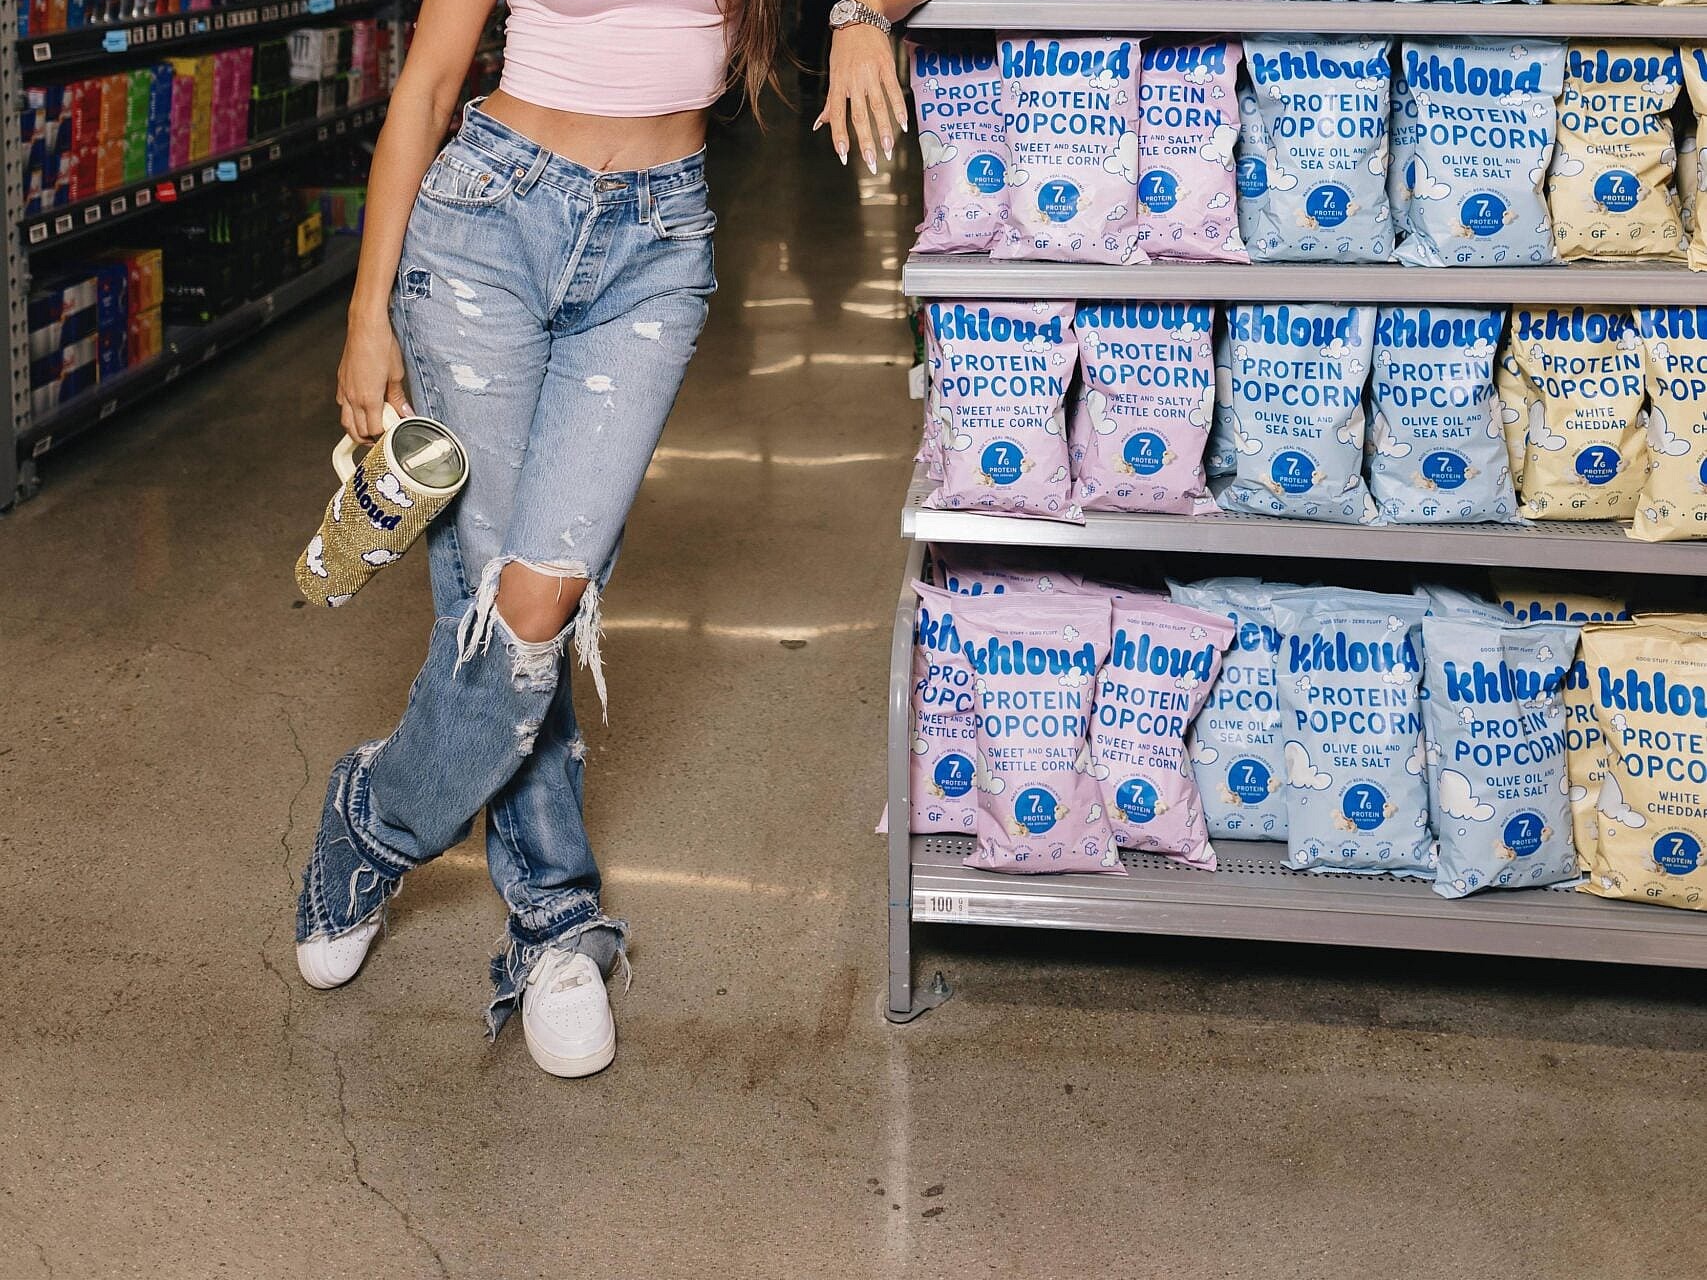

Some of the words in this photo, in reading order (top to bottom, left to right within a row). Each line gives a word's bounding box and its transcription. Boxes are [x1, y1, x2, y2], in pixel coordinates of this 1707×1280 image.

[1001, 41, 1131, 80] khloud
[1252, 47, 1392, 86] khloud
[1407, 50, 1542, 97] khloud
[1018, 90, 1110, 111] PROTEIN
[1280, 94, 1379, 112] PROTEIN
[1564, 91, 1664, 113] PROTEIN
[1428, 103, 1527, 125] PROTEIN
[1004, 113, 1126, 137] POPCORN
[1415, 124, 1548, 149] POPCORN
[1014, 143, 1051, 153] SWEET
[1072, 143, 1108, 154] SALTY
[1019, 155, 1063, 166] KETTLE
[1067, 155, 1101, 166] CORN
[1442, 155, 1479, 166] OLIVE
[1483, 156, 1502, 167] OIL
[1454, 168, 1478, 178] SEA
[1483, 168, 1511, 179] SALT
[1591, 229, 1607, 239] GF
[1457, 252, 1471, 262] GF
[930, 303, 1063, 345] khloud
[1230, 305, 1362, 347] khloud
[1375, 309, 1502, 348] khloud
[952, 354, 1047, 372] PROTEIN
[1096, 343, 1193, 363] PROTEIN
[1242, 359, 1343, 381] PROTEIN
[1388, 362, 1490, 382] PROTEIN
[1542, 353, 1640, 374] PROTEIN
[1086, 364, 1209, 388] POPCORN
[942, 376, 1064, 397] POPCORN
[1232, 379, 1361, 408] POPCORN
[1378, 382, 1496, 408] POPCORN
[956, 405, 992, 416] SWEET
[1014, 405, 1049, 415] SALTY
[1402, 415, 1439, 427] OLIVE
[1443, 415, 1464, 426] OIL
[1466, 414, 1482, 422] AND
[1575, 407, 1615, 418] WHITE
[1413, 427, 1437, 438] SEA
[1442, 427, 1471, 438] SALT
[1566, 420, 1627, 430] CHEDDAR
[1422, 506, 1437, 516] GF
[1571, 500, 1586, 509] GF
[963, 636, 1098, 677] khloud
[1289, 631, 1420, 674] khloud
[982, 691, 1081, 710] PROTEIN
[1102, 681, 1190, 712] PROTEIN
[1308, 687, 1407, 707] PROTEIN
[1296, 710, 1423, 735] POPCORN
[988, 747, 1025, 759] SWEET
[1027, 747, 1043, 755] AND
[1045, 748, 1080, 759] SALTY
[1322, 743, 1358, 755] OLIVE
[1363, 744, 1383, 755] OIL
[1454, 729, 1568, 767] POPCORN
[994, 760, 1037, 772] KETTLE
[1041, 760, 1075, 771] CORN
[1334, 756, 1358, 767] SEA
[1361, 757, 1391, 769] SALT
[1659, 790, 1700, 805] WHITE
[1661, 856, 1692, 865] PROTEIN
[1646, 887, 1663, 897] GF
[930, 896, 953, 912] 100
